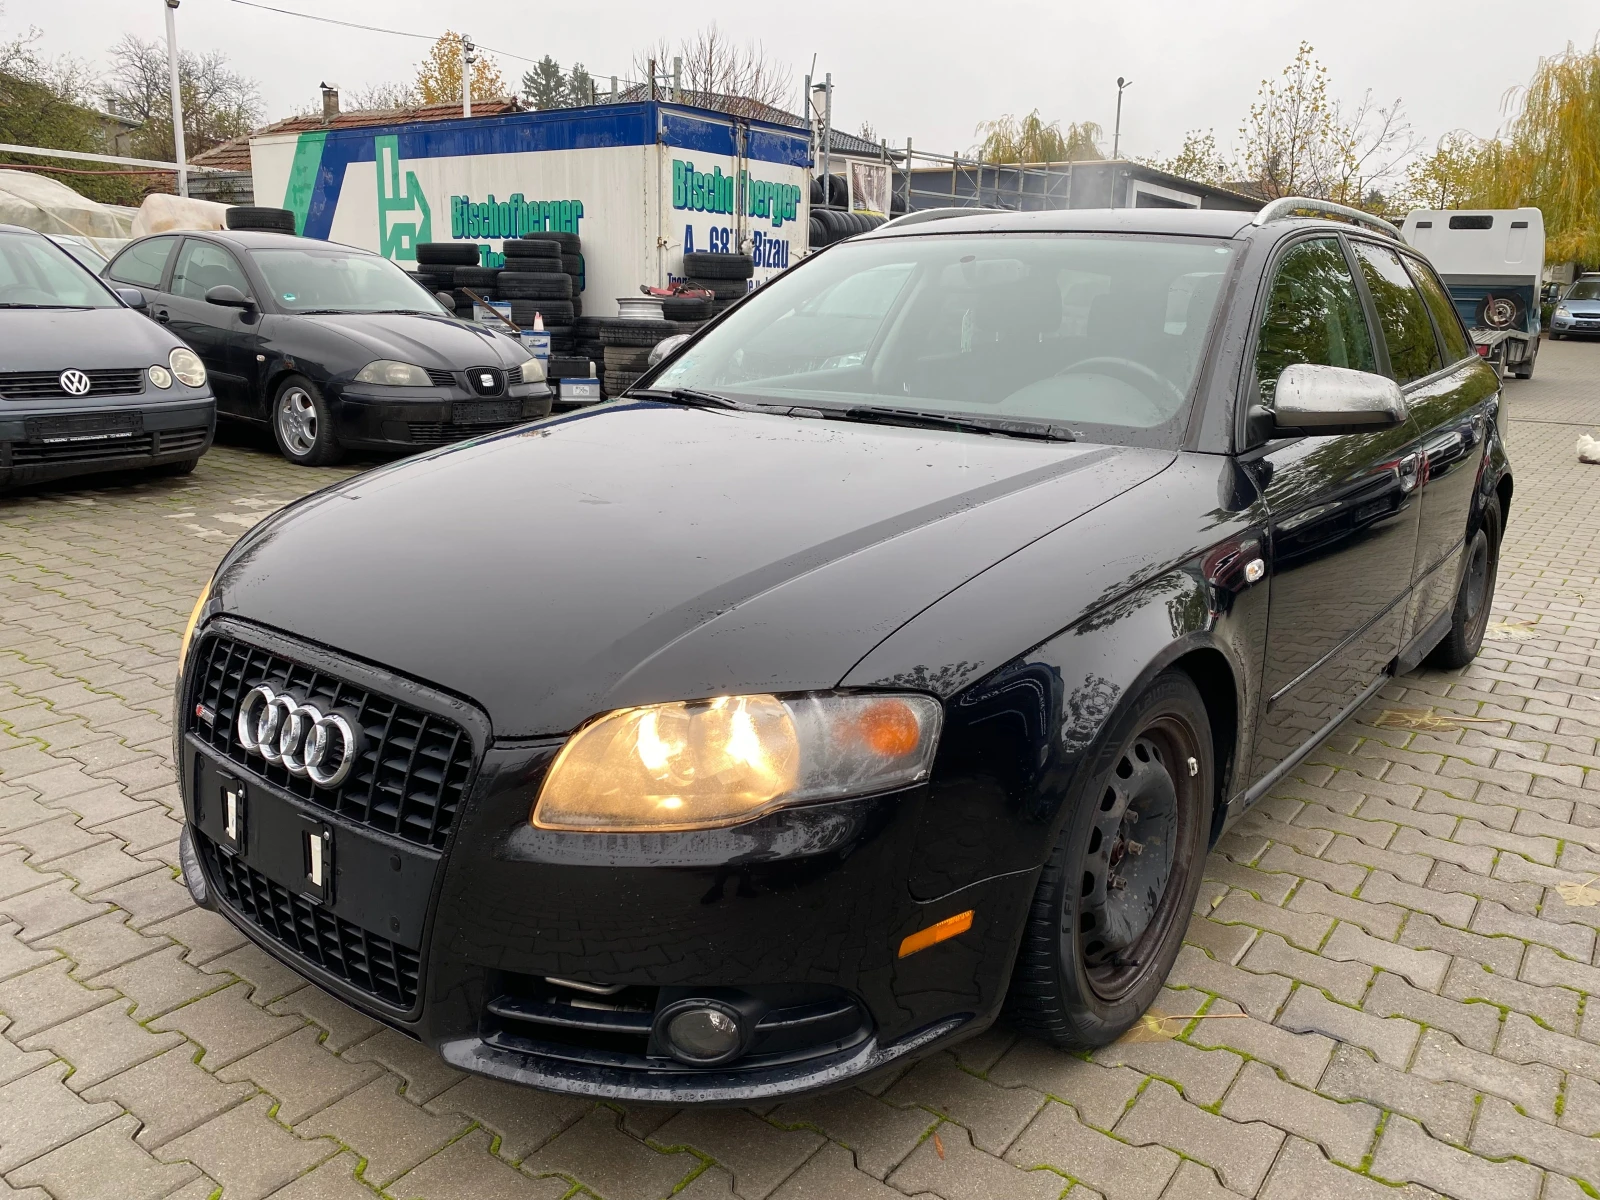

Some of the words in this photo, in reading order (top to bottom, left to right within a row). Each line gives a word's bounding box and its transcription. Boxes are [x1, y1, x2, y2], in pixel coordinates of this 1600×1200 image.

[451, 193, 584, 239] Bischofberger
[673, 159, 801, 227] Bischofberger
[753, 230, 789, 269] Bizau
